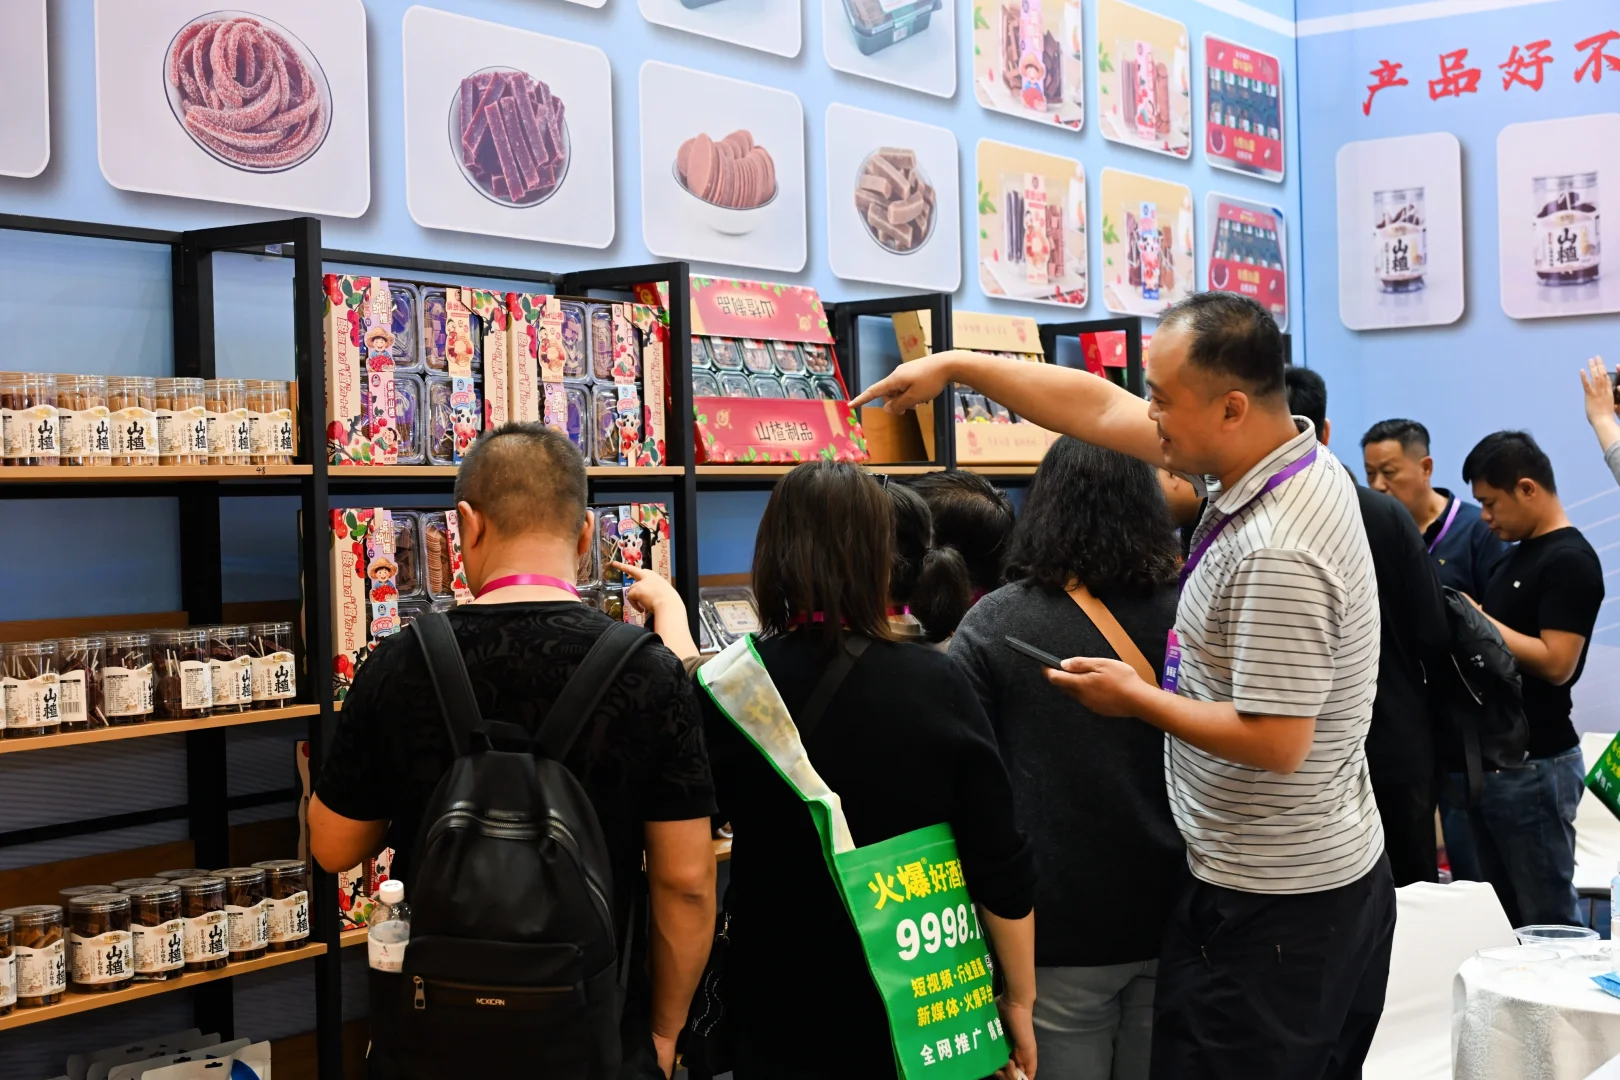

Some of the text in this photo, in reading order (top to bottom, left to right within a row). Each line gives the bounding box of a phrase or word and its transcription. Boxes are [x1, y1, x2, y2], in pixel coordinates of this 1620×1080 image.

[1362, 29, 1620, 116] 产品好不
[1392, 238, 1410, 273] 山楂
[1556, 227, 1579, 264] 山楂
[716, 296, 776, 319] 山楂制品
[38, 419, 55, 451] 山楂
[96, 419, 110, 451] 山楂
[125, 420, 146, 451] 山楂
[194, 419, 207, 449] 山楂
[237, 421, 249, 450] 山楂
[280, 421, 293, 450] 山楂
[755, 420, 814, 442] 山楂制品
[256, 466, 266, 475] 48
[274, 664, 290, 694] 山楂
[43, 687, 59, 719] 山楂
[296, 905, 308, 934] 山楂
[896, 903, 984, 961] 9998.T
[168, 933, 182, 964] 山楂
[208, 924, 224, 955] 山楂
[106, 945, 125, 976] 山楂
[911, 957, 986, 998] 短视频·行业直播
[917, 984, 993, 1027] 新媒体·火爆平台
[920, 1028, 982, 1067] 全网推广
